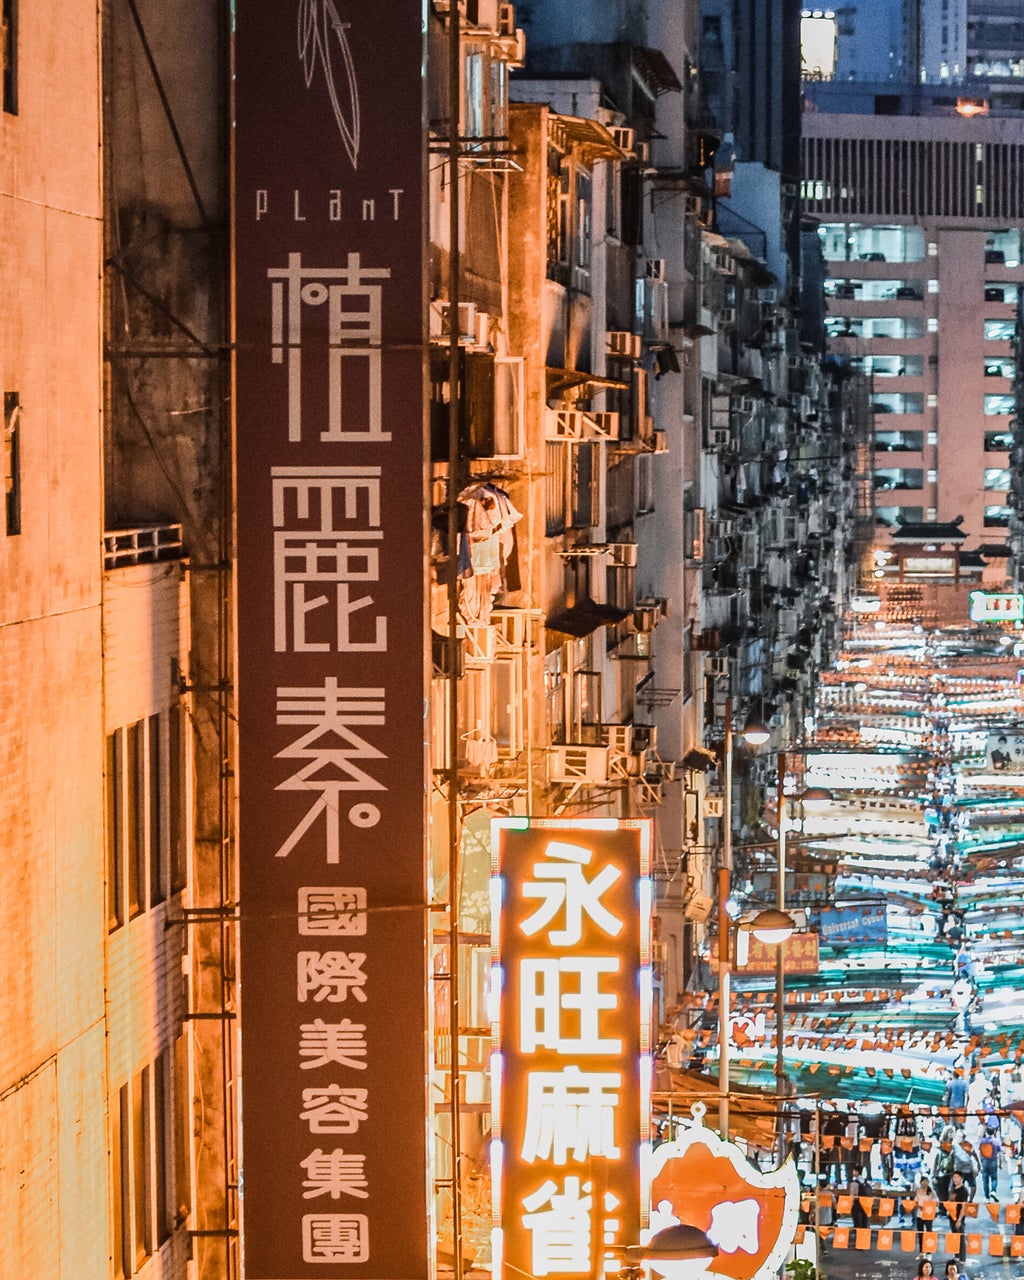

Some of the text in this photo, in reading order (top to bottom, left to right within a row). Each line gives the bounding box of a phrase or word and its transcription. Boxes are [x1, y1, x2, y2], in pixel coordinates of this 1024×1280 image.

[297, 886, 370, 1264] 國際美容集團
